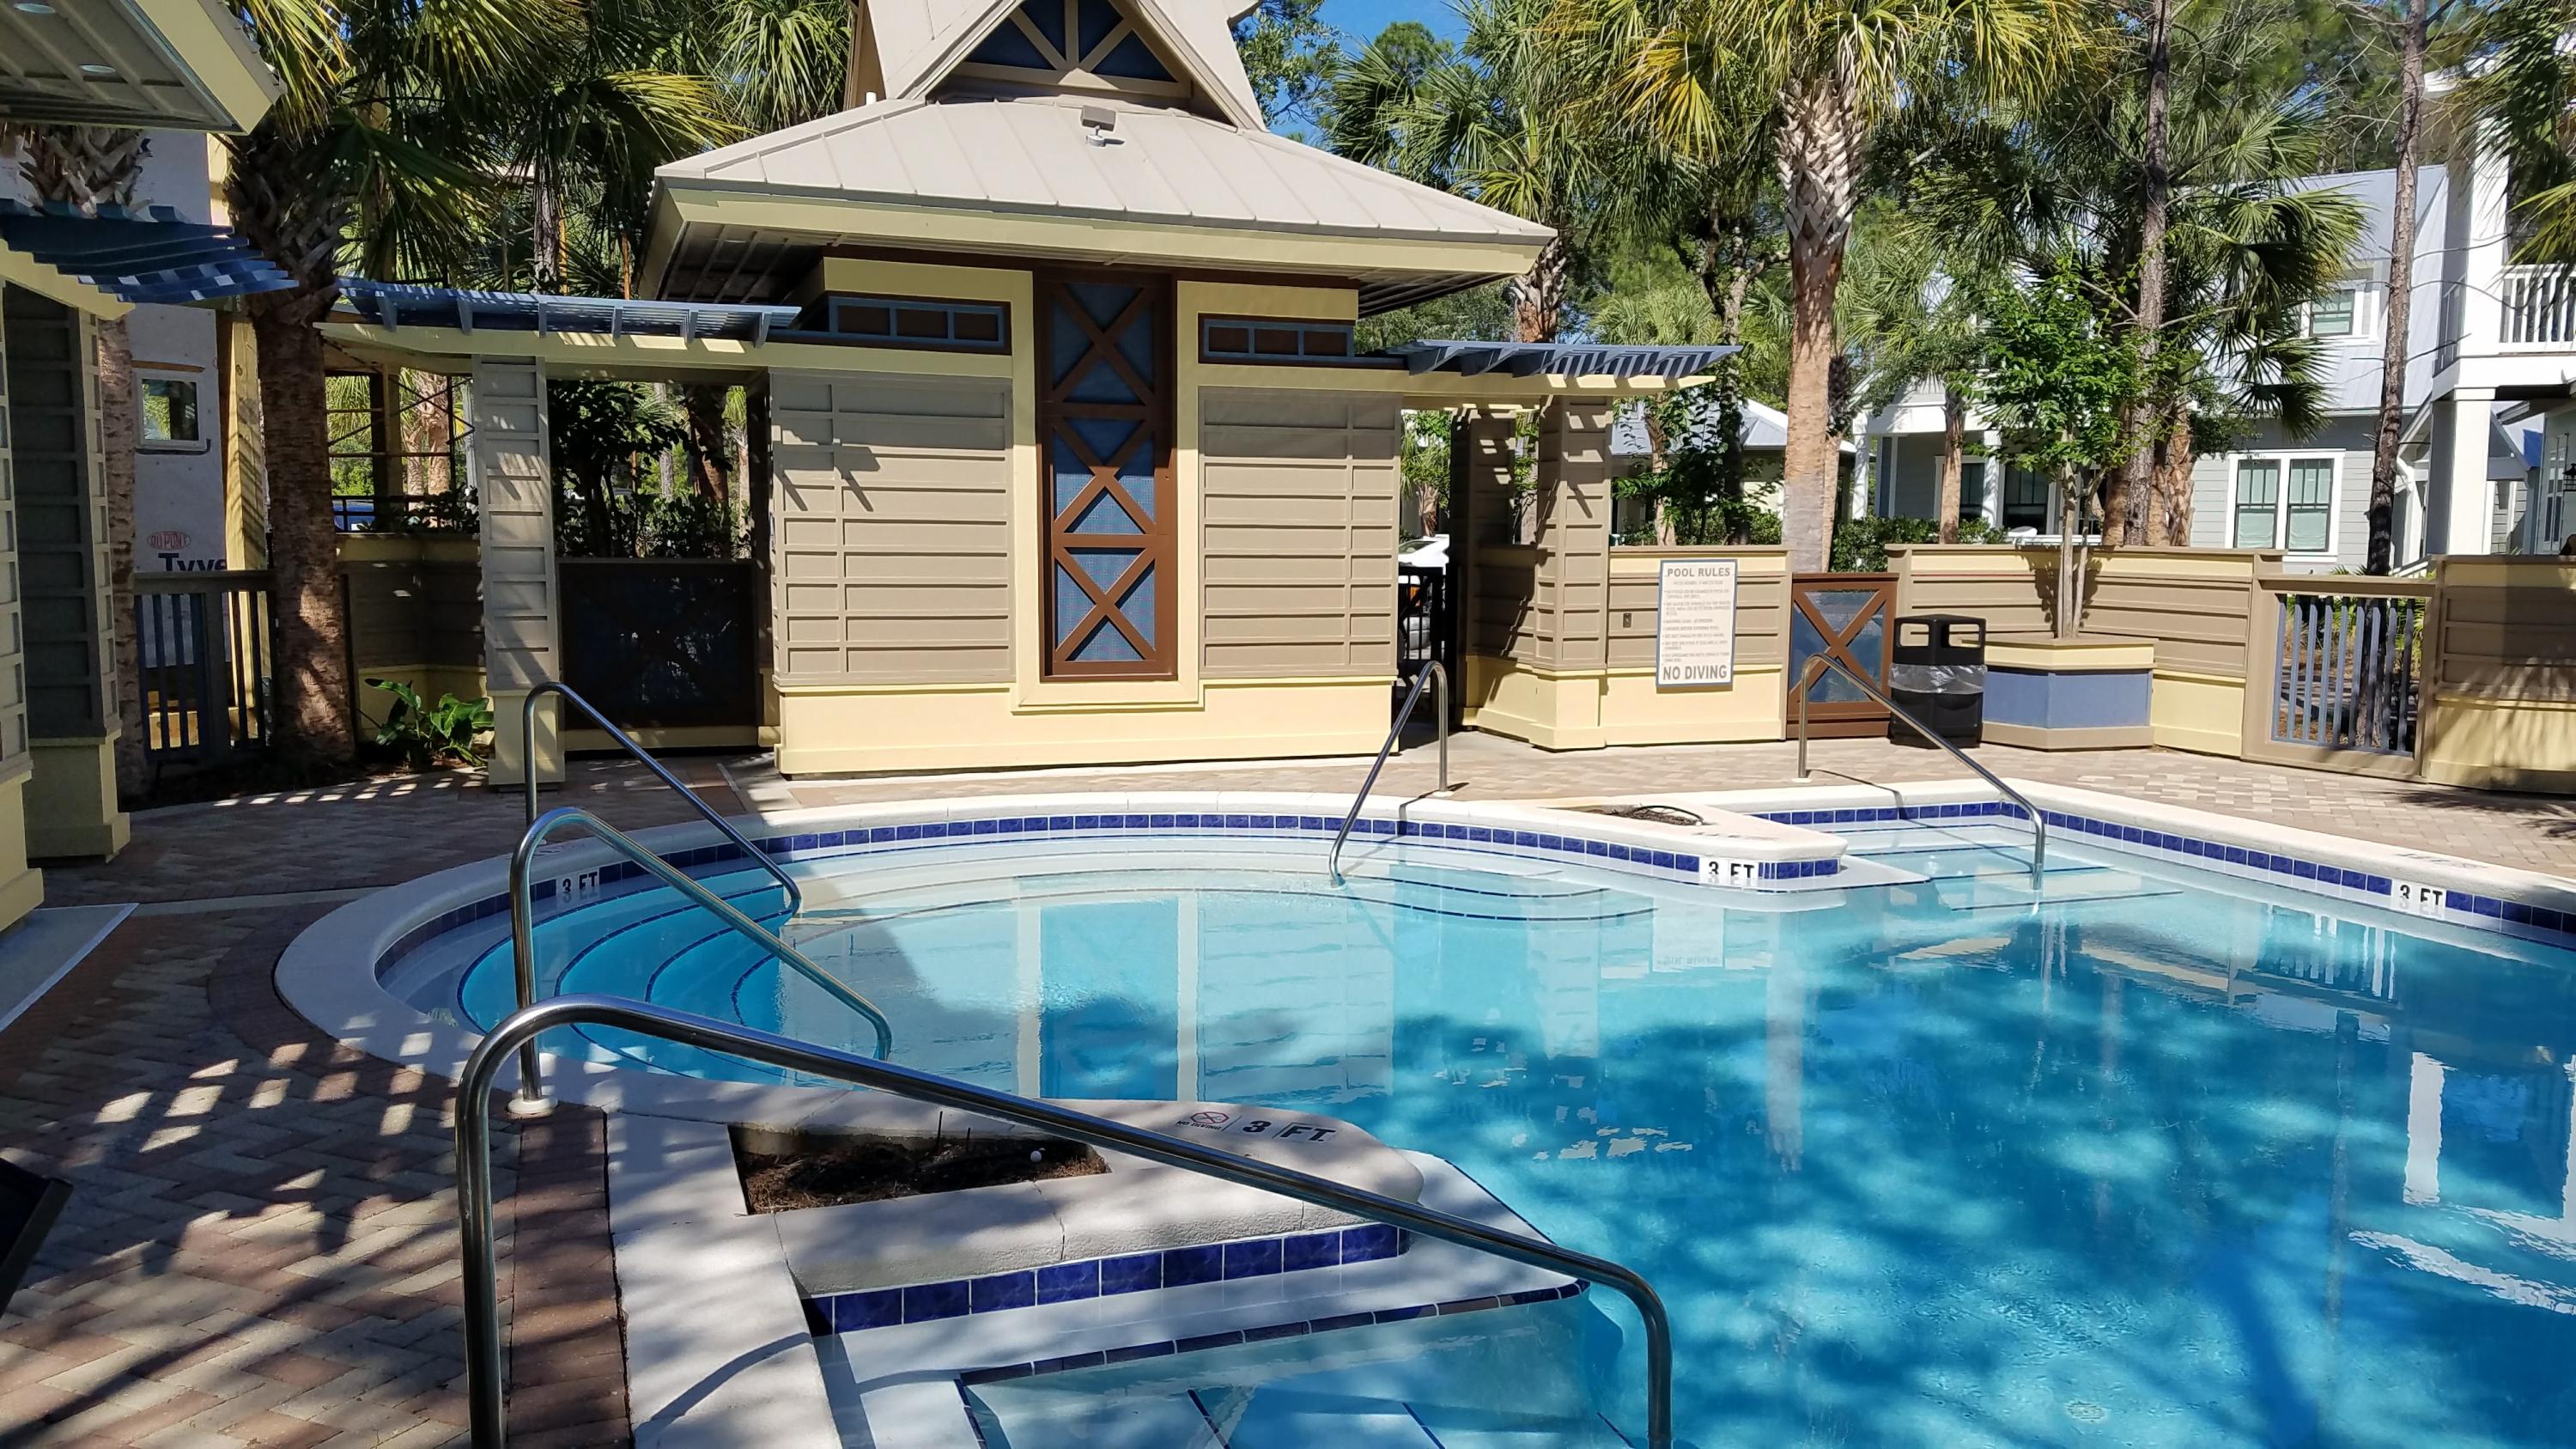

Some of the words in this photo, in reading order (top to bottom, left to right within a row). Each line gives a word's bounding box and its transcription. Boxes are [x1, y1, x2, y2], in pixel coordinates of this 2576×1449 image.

[1668, 568, 1694, 577] POOL
[1698, 567, 1730, 577] RULES
[1663, 666, 1680, 680] NO
[1685, 665, 1728, 679] DIVING
[1730, 862, 1754, 878] FT
[562, 878, 572, 893] 3
[579, 871, 598, 890] FT
[2420, 888, 2443, 905] FT
[1242, 1120, 1271, 1133] 3
